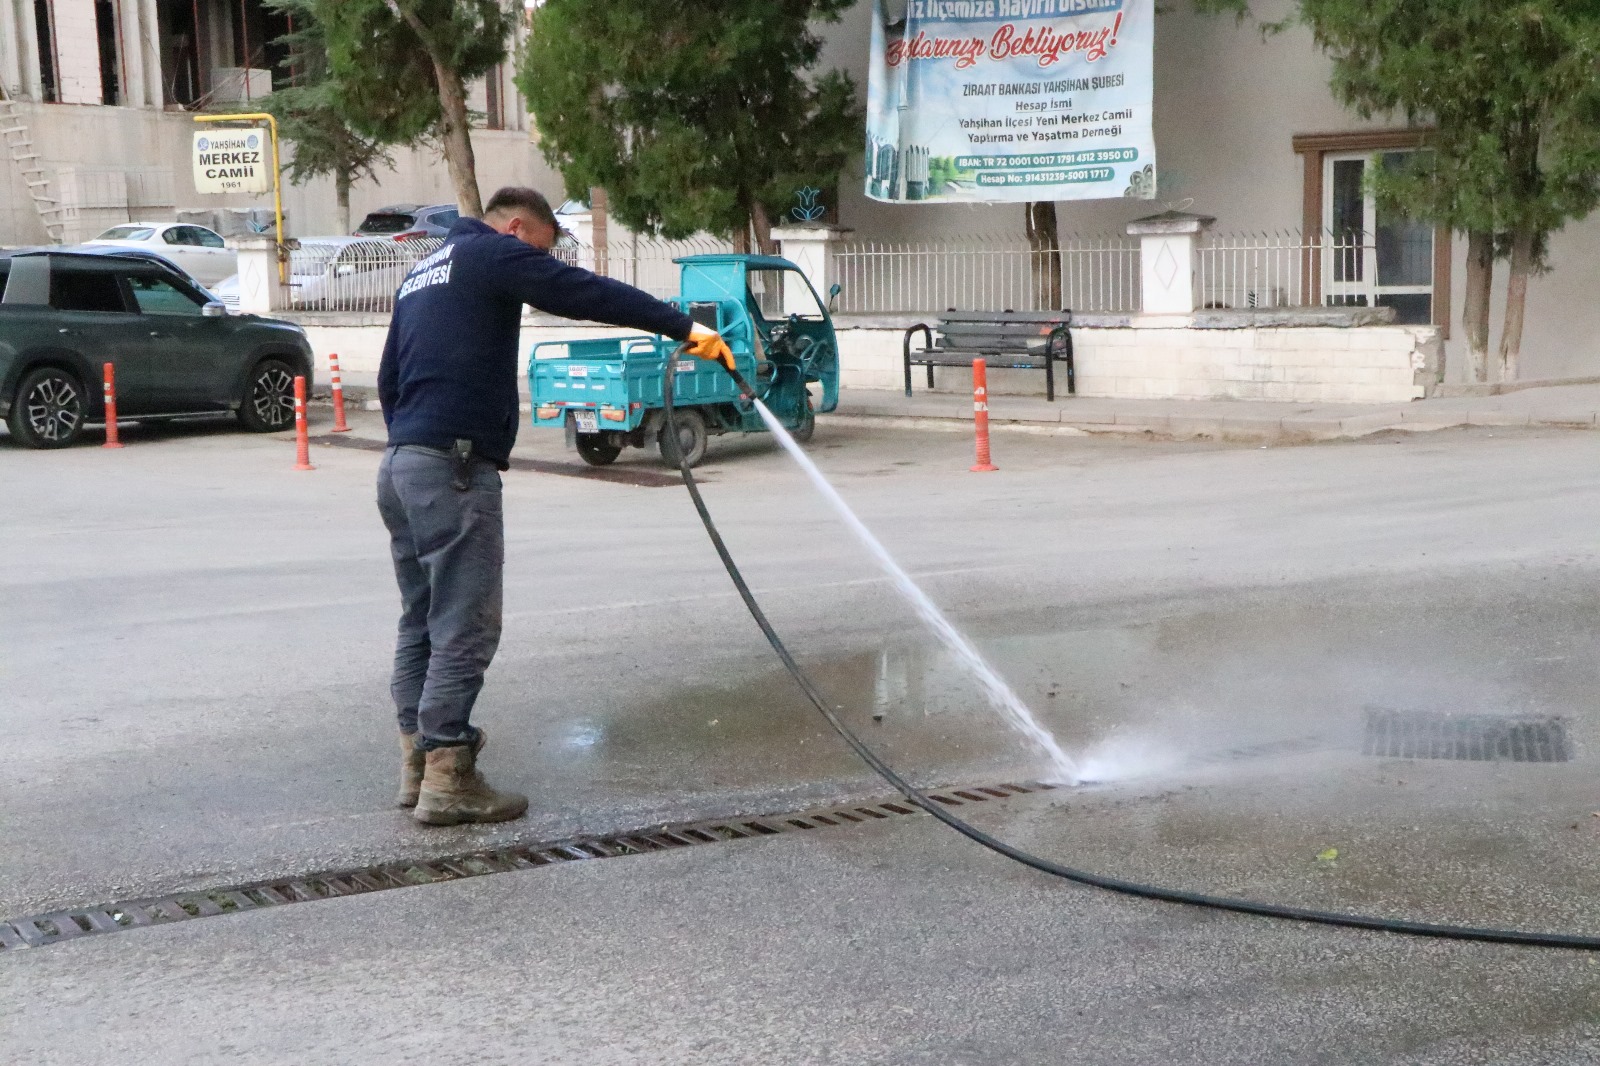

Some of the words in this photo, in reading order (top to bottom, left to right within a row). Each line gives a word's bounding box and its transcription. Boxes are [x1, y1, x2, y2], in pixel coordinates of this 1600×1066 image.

[990, 11, 1123, 68] Bekliyoruz!
[963, 83, 997, 97] ZİRAAT
[999, 82, 1041, 95] BANKASI
[1043, 77, 1090, 95] YAHŞİHAN
[1092, 72, 1124, 90] ŞUBESİ
[1015, 101, 1048, 112] Hesap
[1050, 98, 1072, 109] İsmi
[959, 118, 1003, 130] Yahşihan
[1005, 116, 1033, 128] İlçesi
[1036, 115, 1058, 127] Yeni
[1061, 112, 1100, 124] Merkez
[1102, 109, 1133, 121] Camii
[968, 133, 1014, 144] Yaptırma
[1017, 133, 1029, 141] ve
[1032, 130, 1079, 142] Yaşatma
[1082, 125, 1122, 138] Derneği
[210, 139, 246, 151] YAHŞİHAN
[199, 151, 260, 166] MERKEZ
[959, 158, 981, 167] IBAN:
[983, 158, 995, 167] TR
[996, 157, 1008, 167] 72
[1008, 157, 1031, 166] 0001
[1033, 156, 1055, 165] 0017
[1057, 154, 1075, 163] 1791
[1076, 152, 1096, 162] 4312
[1097, 150, 1121, 161] 3950
[1122, 149, 1134, 159] 01
[205, 166, 255, 179] CAMİİ
[980, 174, 1006, 184] Hesap
[1007, 173, 1023, 183] No:
[1025, 170, 1089, 182] 91431239-5001
[1090, 168, 1110, 178] 1717
[221, 181, 242, 189] 1961
